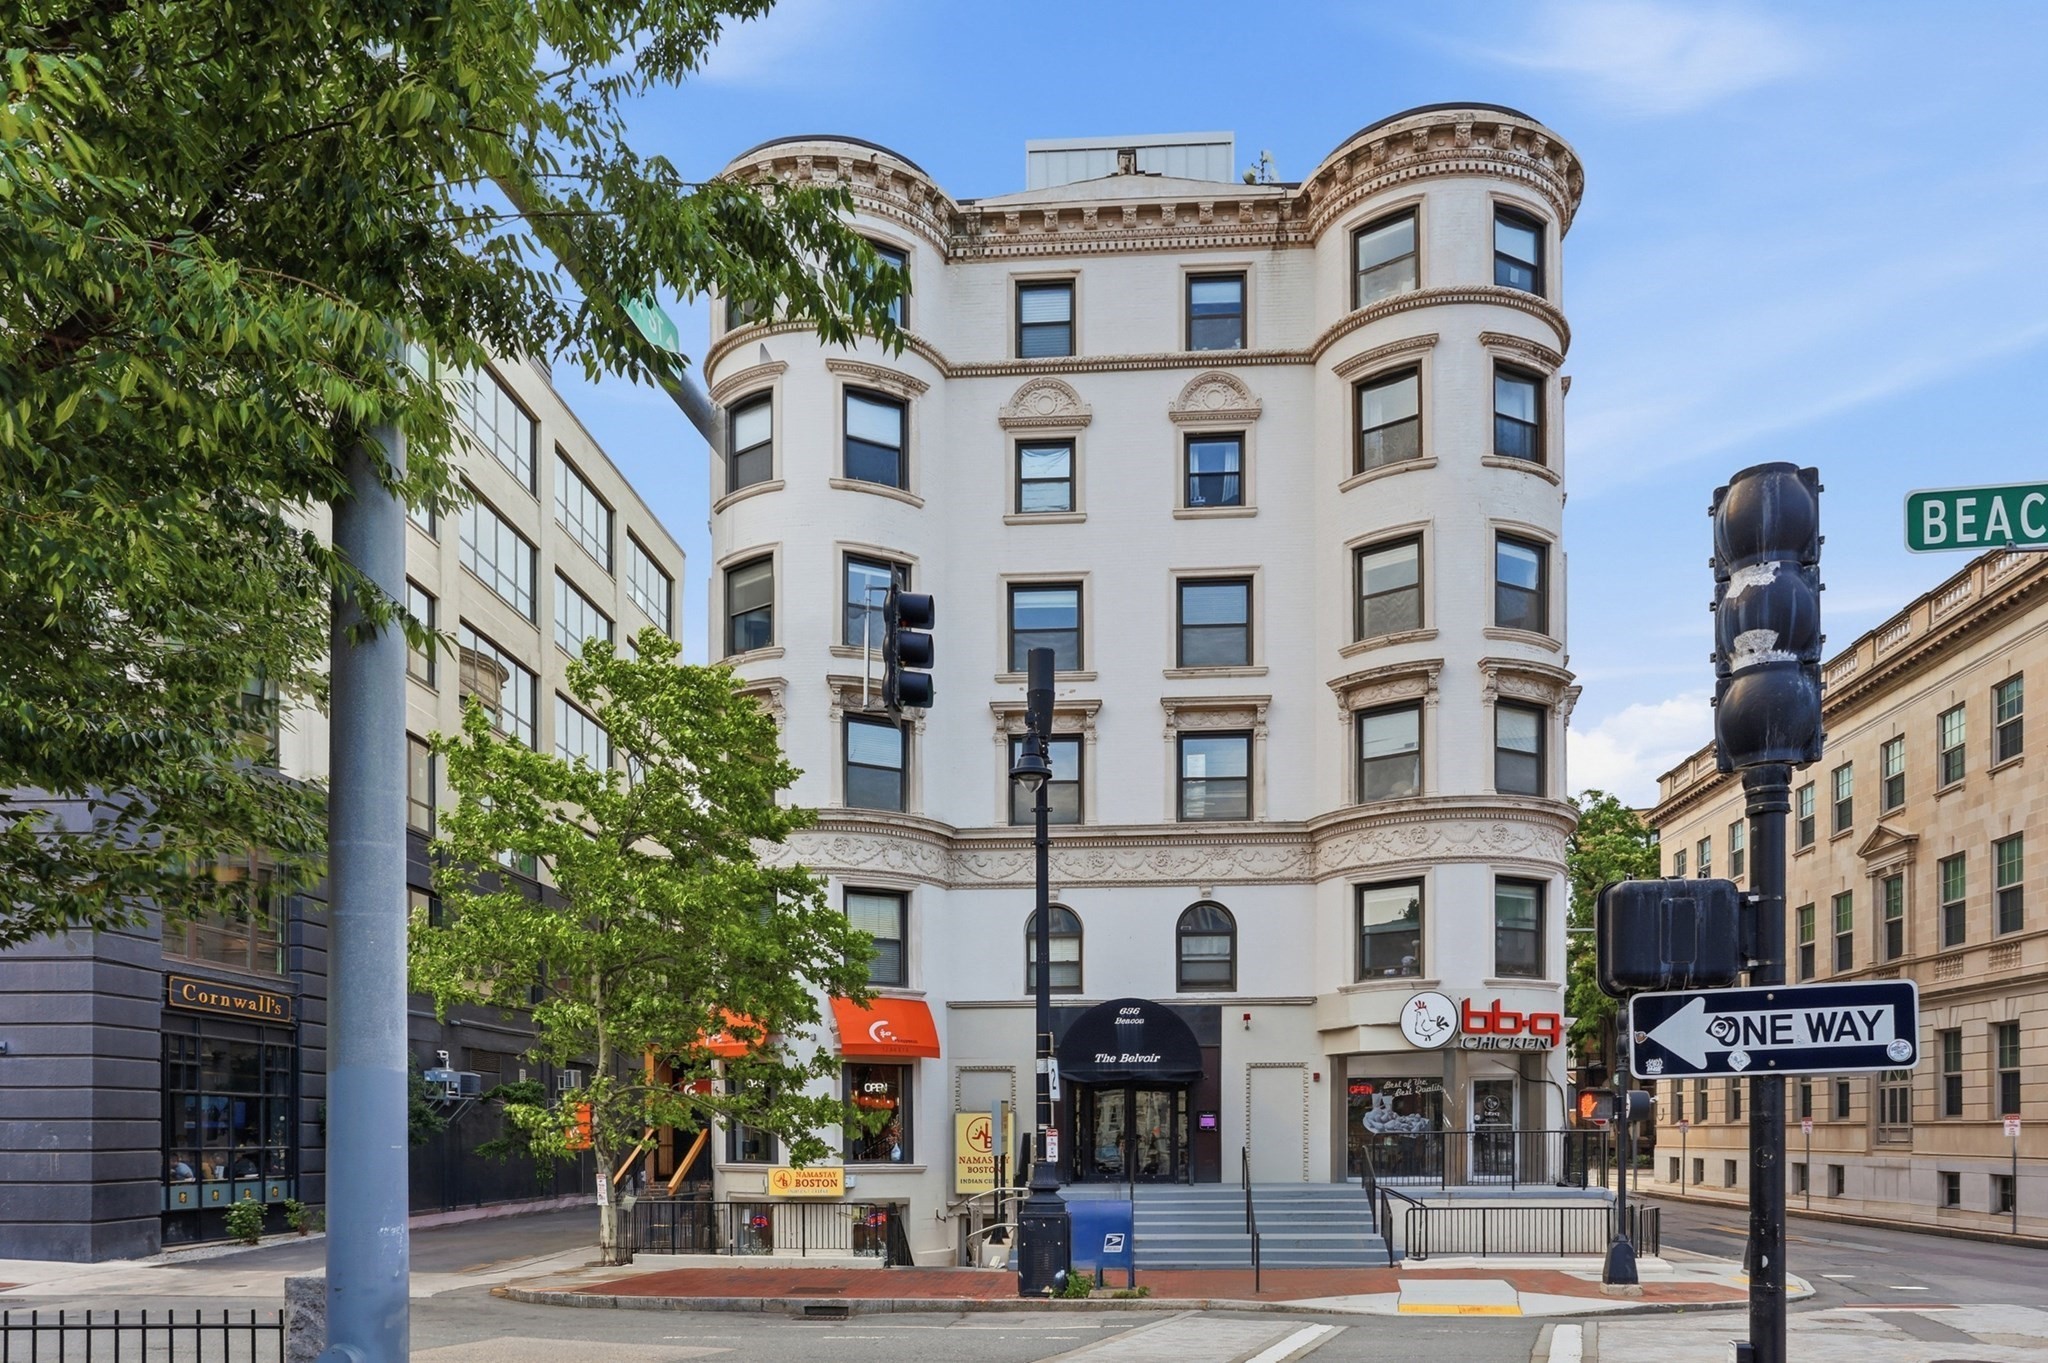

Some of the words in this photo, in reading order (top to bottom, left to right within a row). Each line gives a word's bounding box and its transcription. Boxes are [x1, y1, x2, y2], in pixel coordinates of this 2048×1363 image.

[1923, 492, 2047, 545] BEAC
[182, 983, 282, 1015] Cornwall's
[1717, 1014, 1794, 1047] ONE
[1804, 1009, 1885, 1043] WAY
[1461, 1036, 1550, 1050] CHICKEN
[1094, 1053, 1117, 1063] The
[1119, 1053, 1161, 1063] Belvoir
[864, 1082, 888, 1093] OPEN
[958, 1156, 1011, 1164] NAMASY
[795, 1179, 838, 1188] BOSTON
